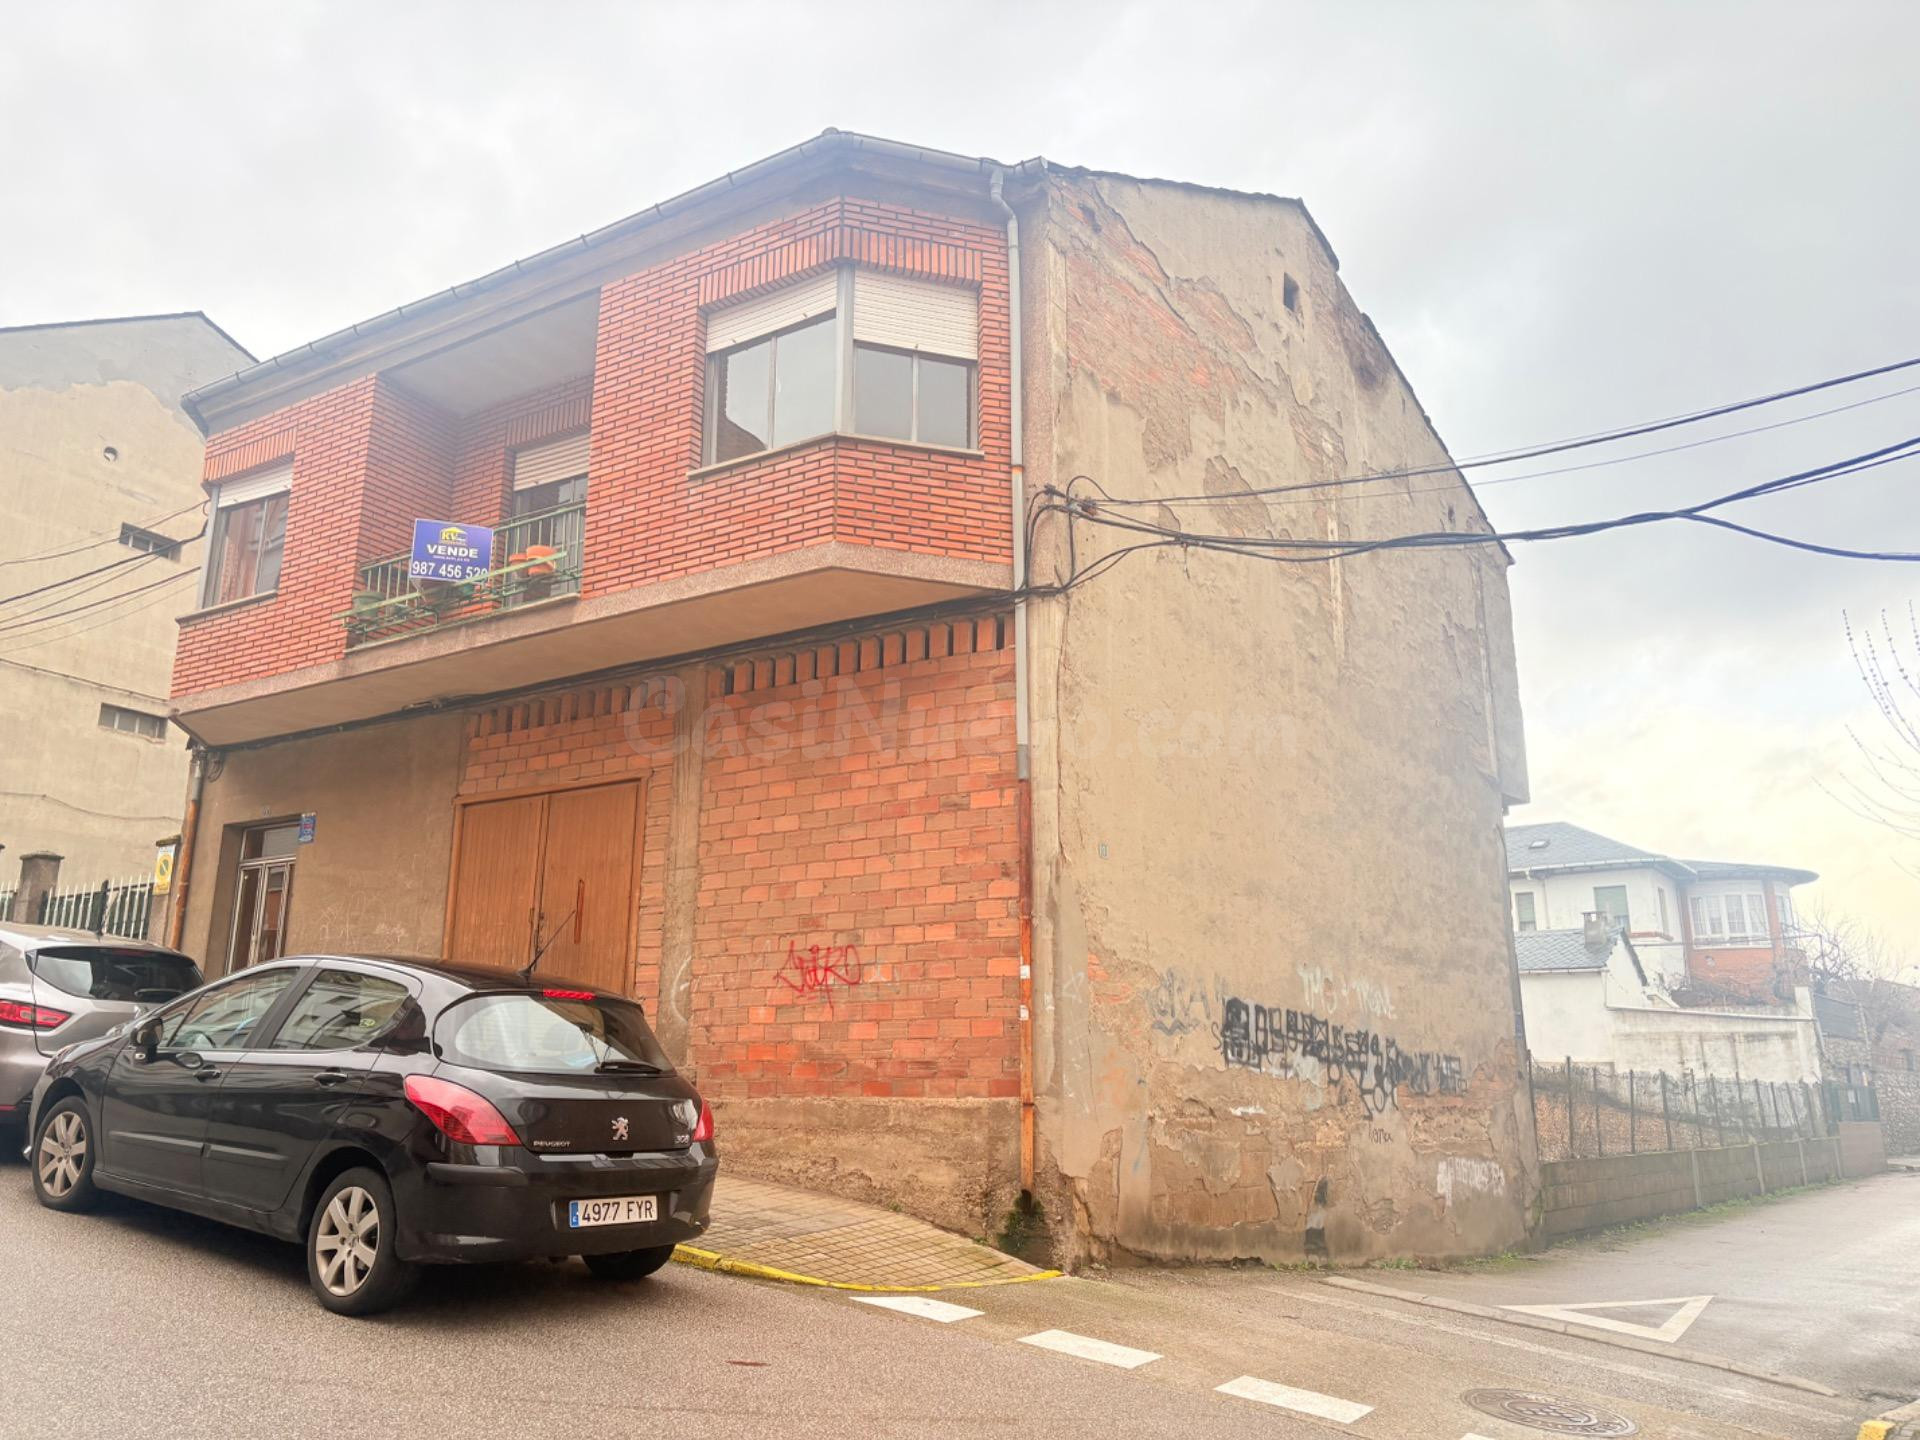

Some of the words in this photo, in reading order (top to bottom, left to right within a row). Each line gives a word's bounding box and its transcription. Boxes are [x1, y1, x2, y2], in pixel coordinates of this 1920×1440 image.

[426, 544, 478, 558] VENDE
[412, 561, 435, 576] 987
[439, 563, 462, 578] 456
[533, 1140, 571, 1148] PEUGEOT
[582, 1202, 621, 1223] 4977
[627, 1200, 653, 1220] FYR
